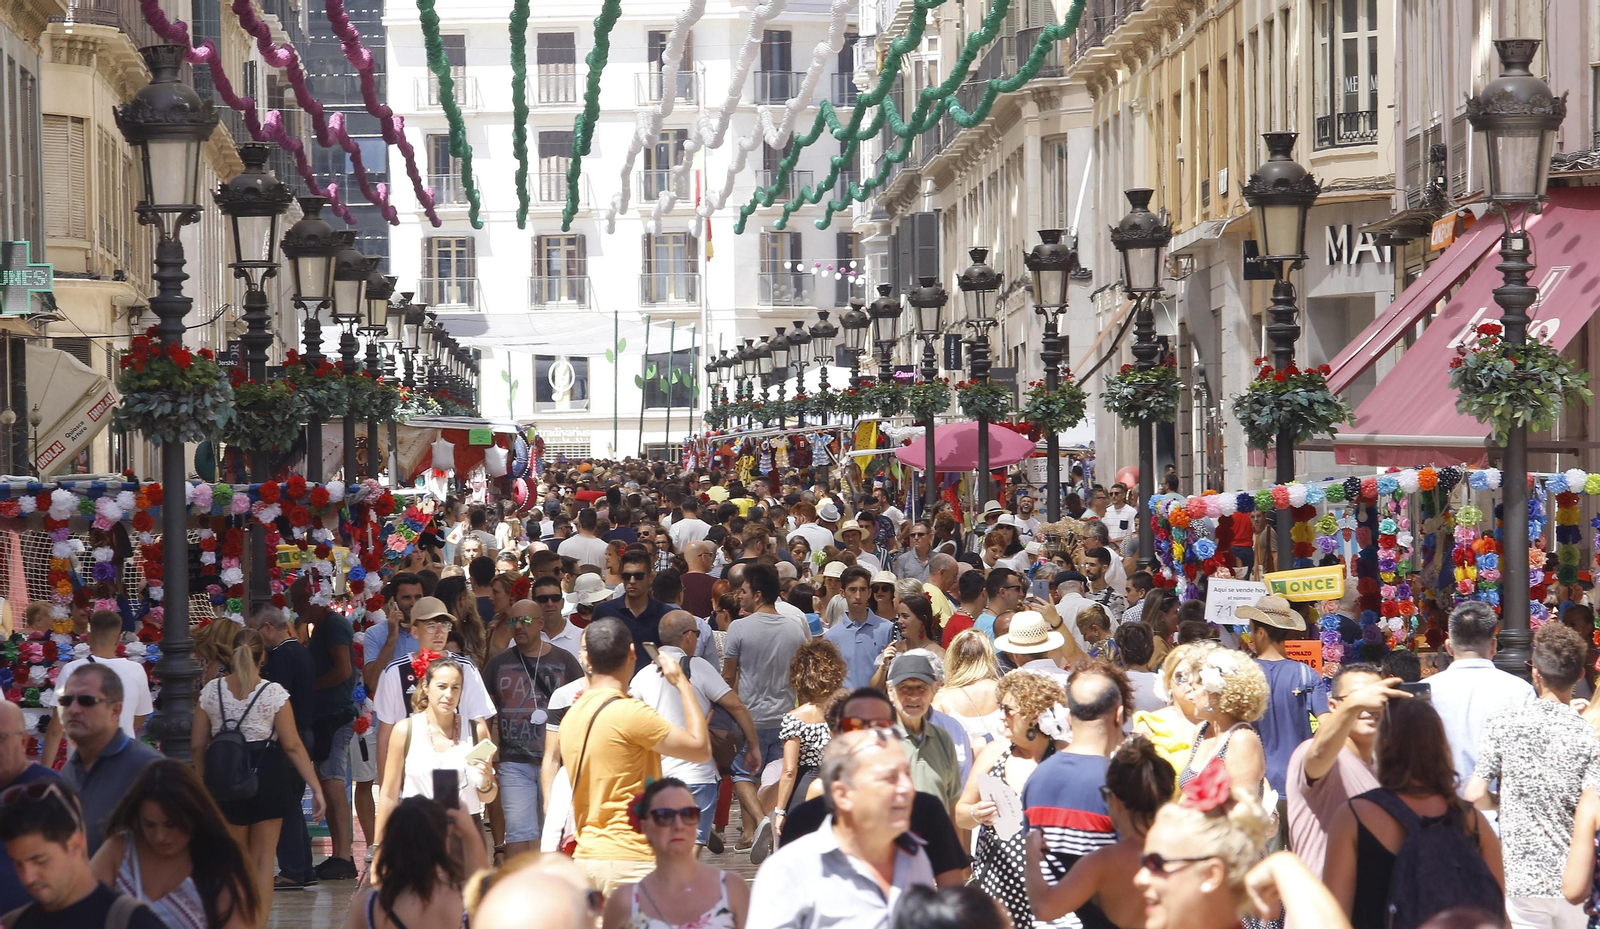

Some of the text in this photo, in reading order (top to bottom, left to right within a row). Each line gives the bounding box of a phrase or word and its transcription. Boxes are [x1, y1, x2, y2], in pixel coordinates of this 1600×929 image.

[71, 426, 87, 441] Arturo
[1213, 586, 1227, 594] Aquí
[1254, 586, 1266, 594] hoy
[1289, 577, 1335, 593] ONCE
